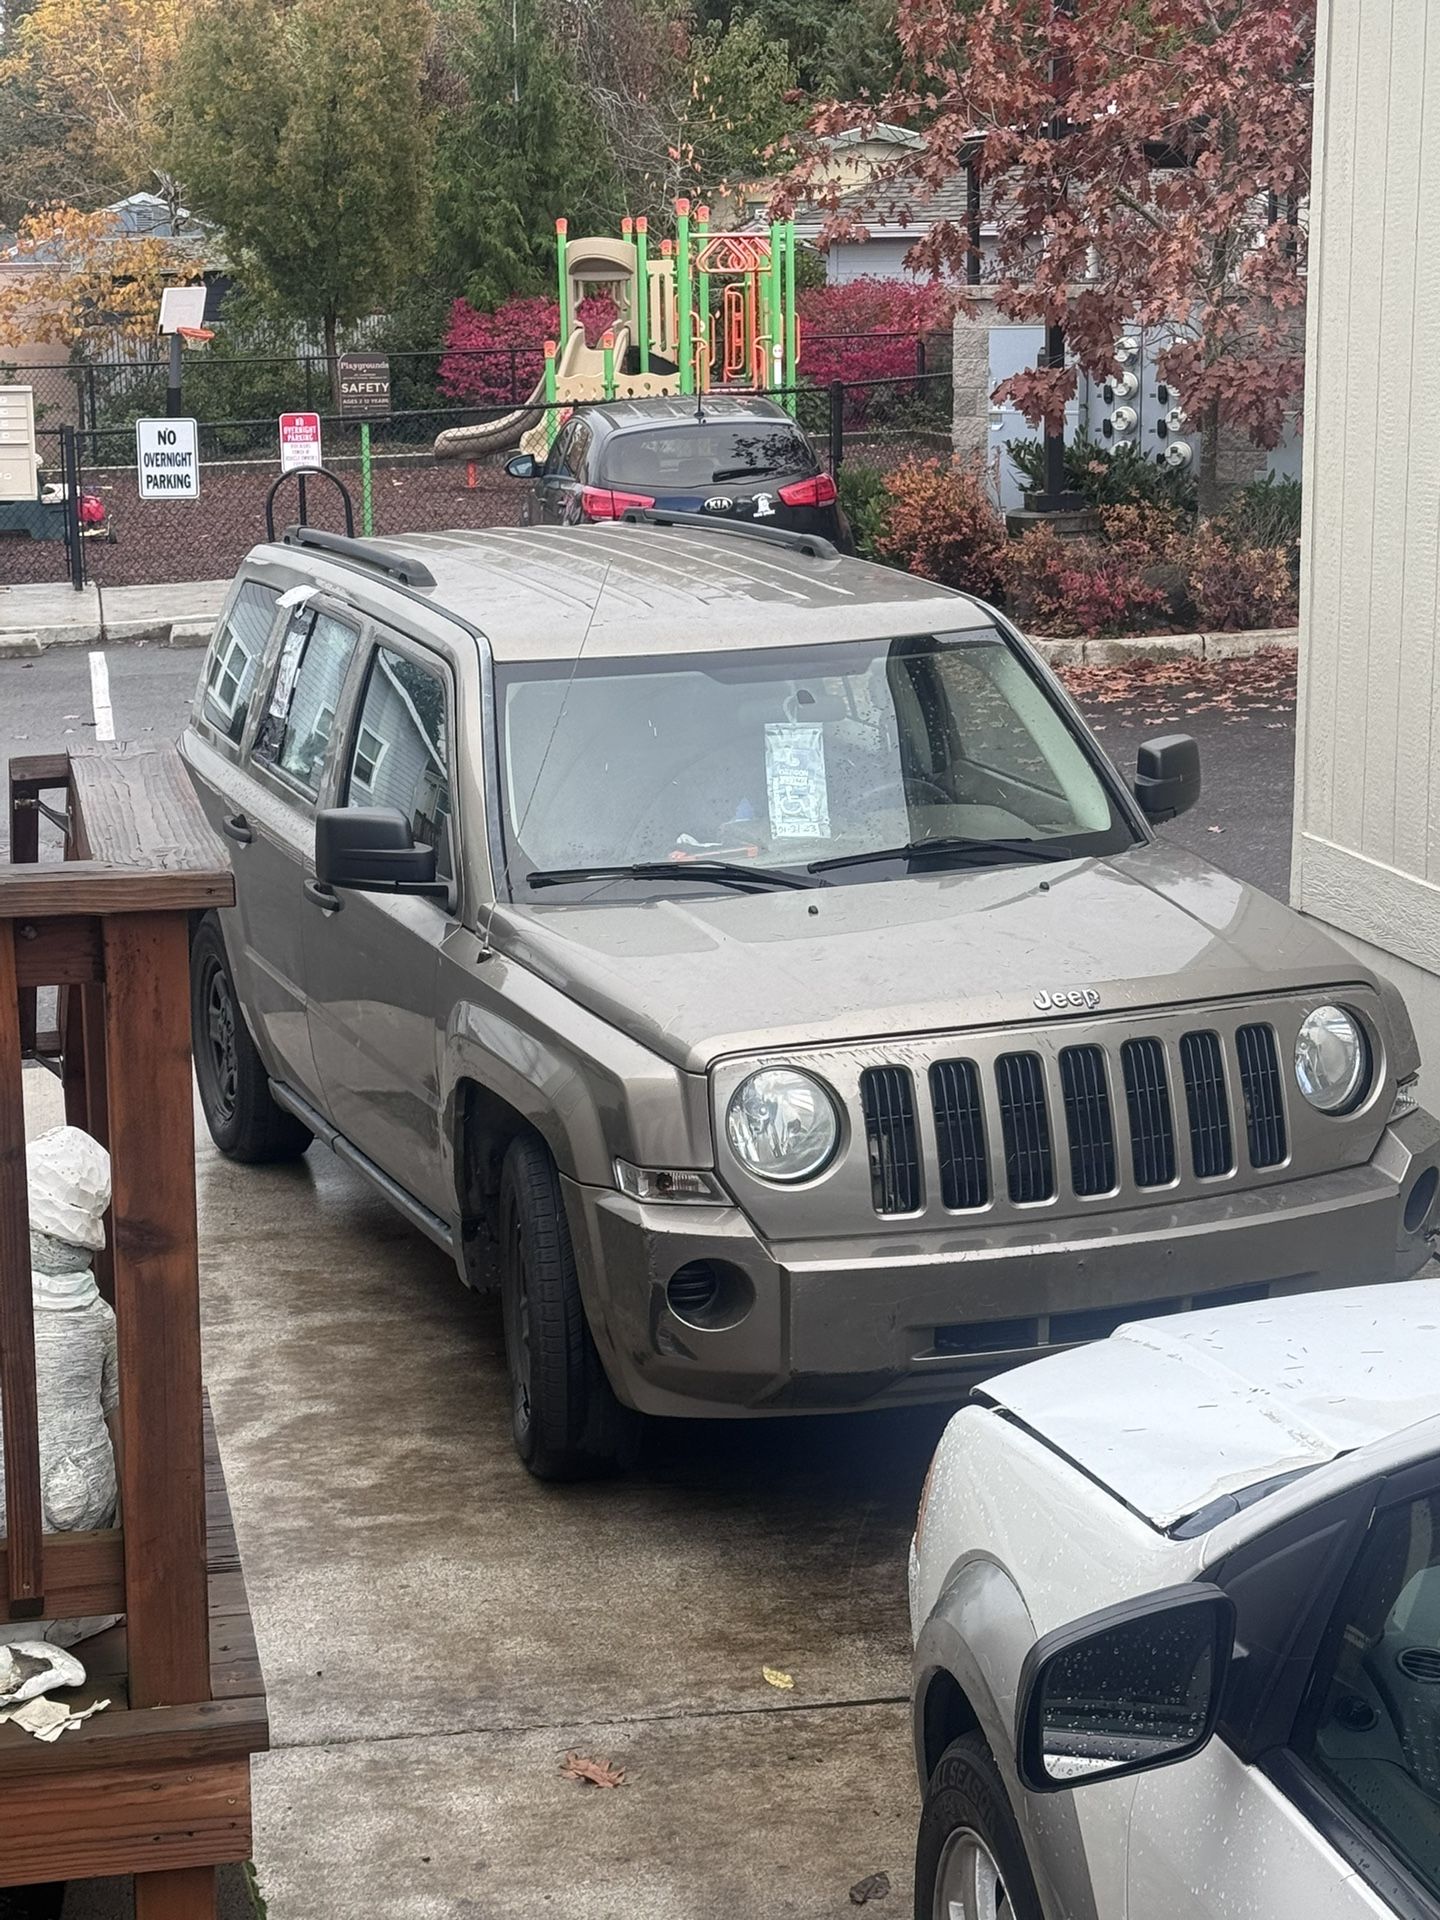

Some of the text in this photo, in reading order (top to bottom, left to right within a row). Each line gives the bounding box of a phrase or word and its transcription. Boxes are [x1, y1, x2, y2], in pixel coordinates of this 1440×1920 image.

[341, 382, 390, 393] SAFETY
[157, 430, 177, 445] NO
[143, 452, 192, 468] OVERNIGHT
[146, 474, 191, 489] PARKING
[708, 499, 729, 510] KIA
[1033, 987, 1101, 1010] Jeep
